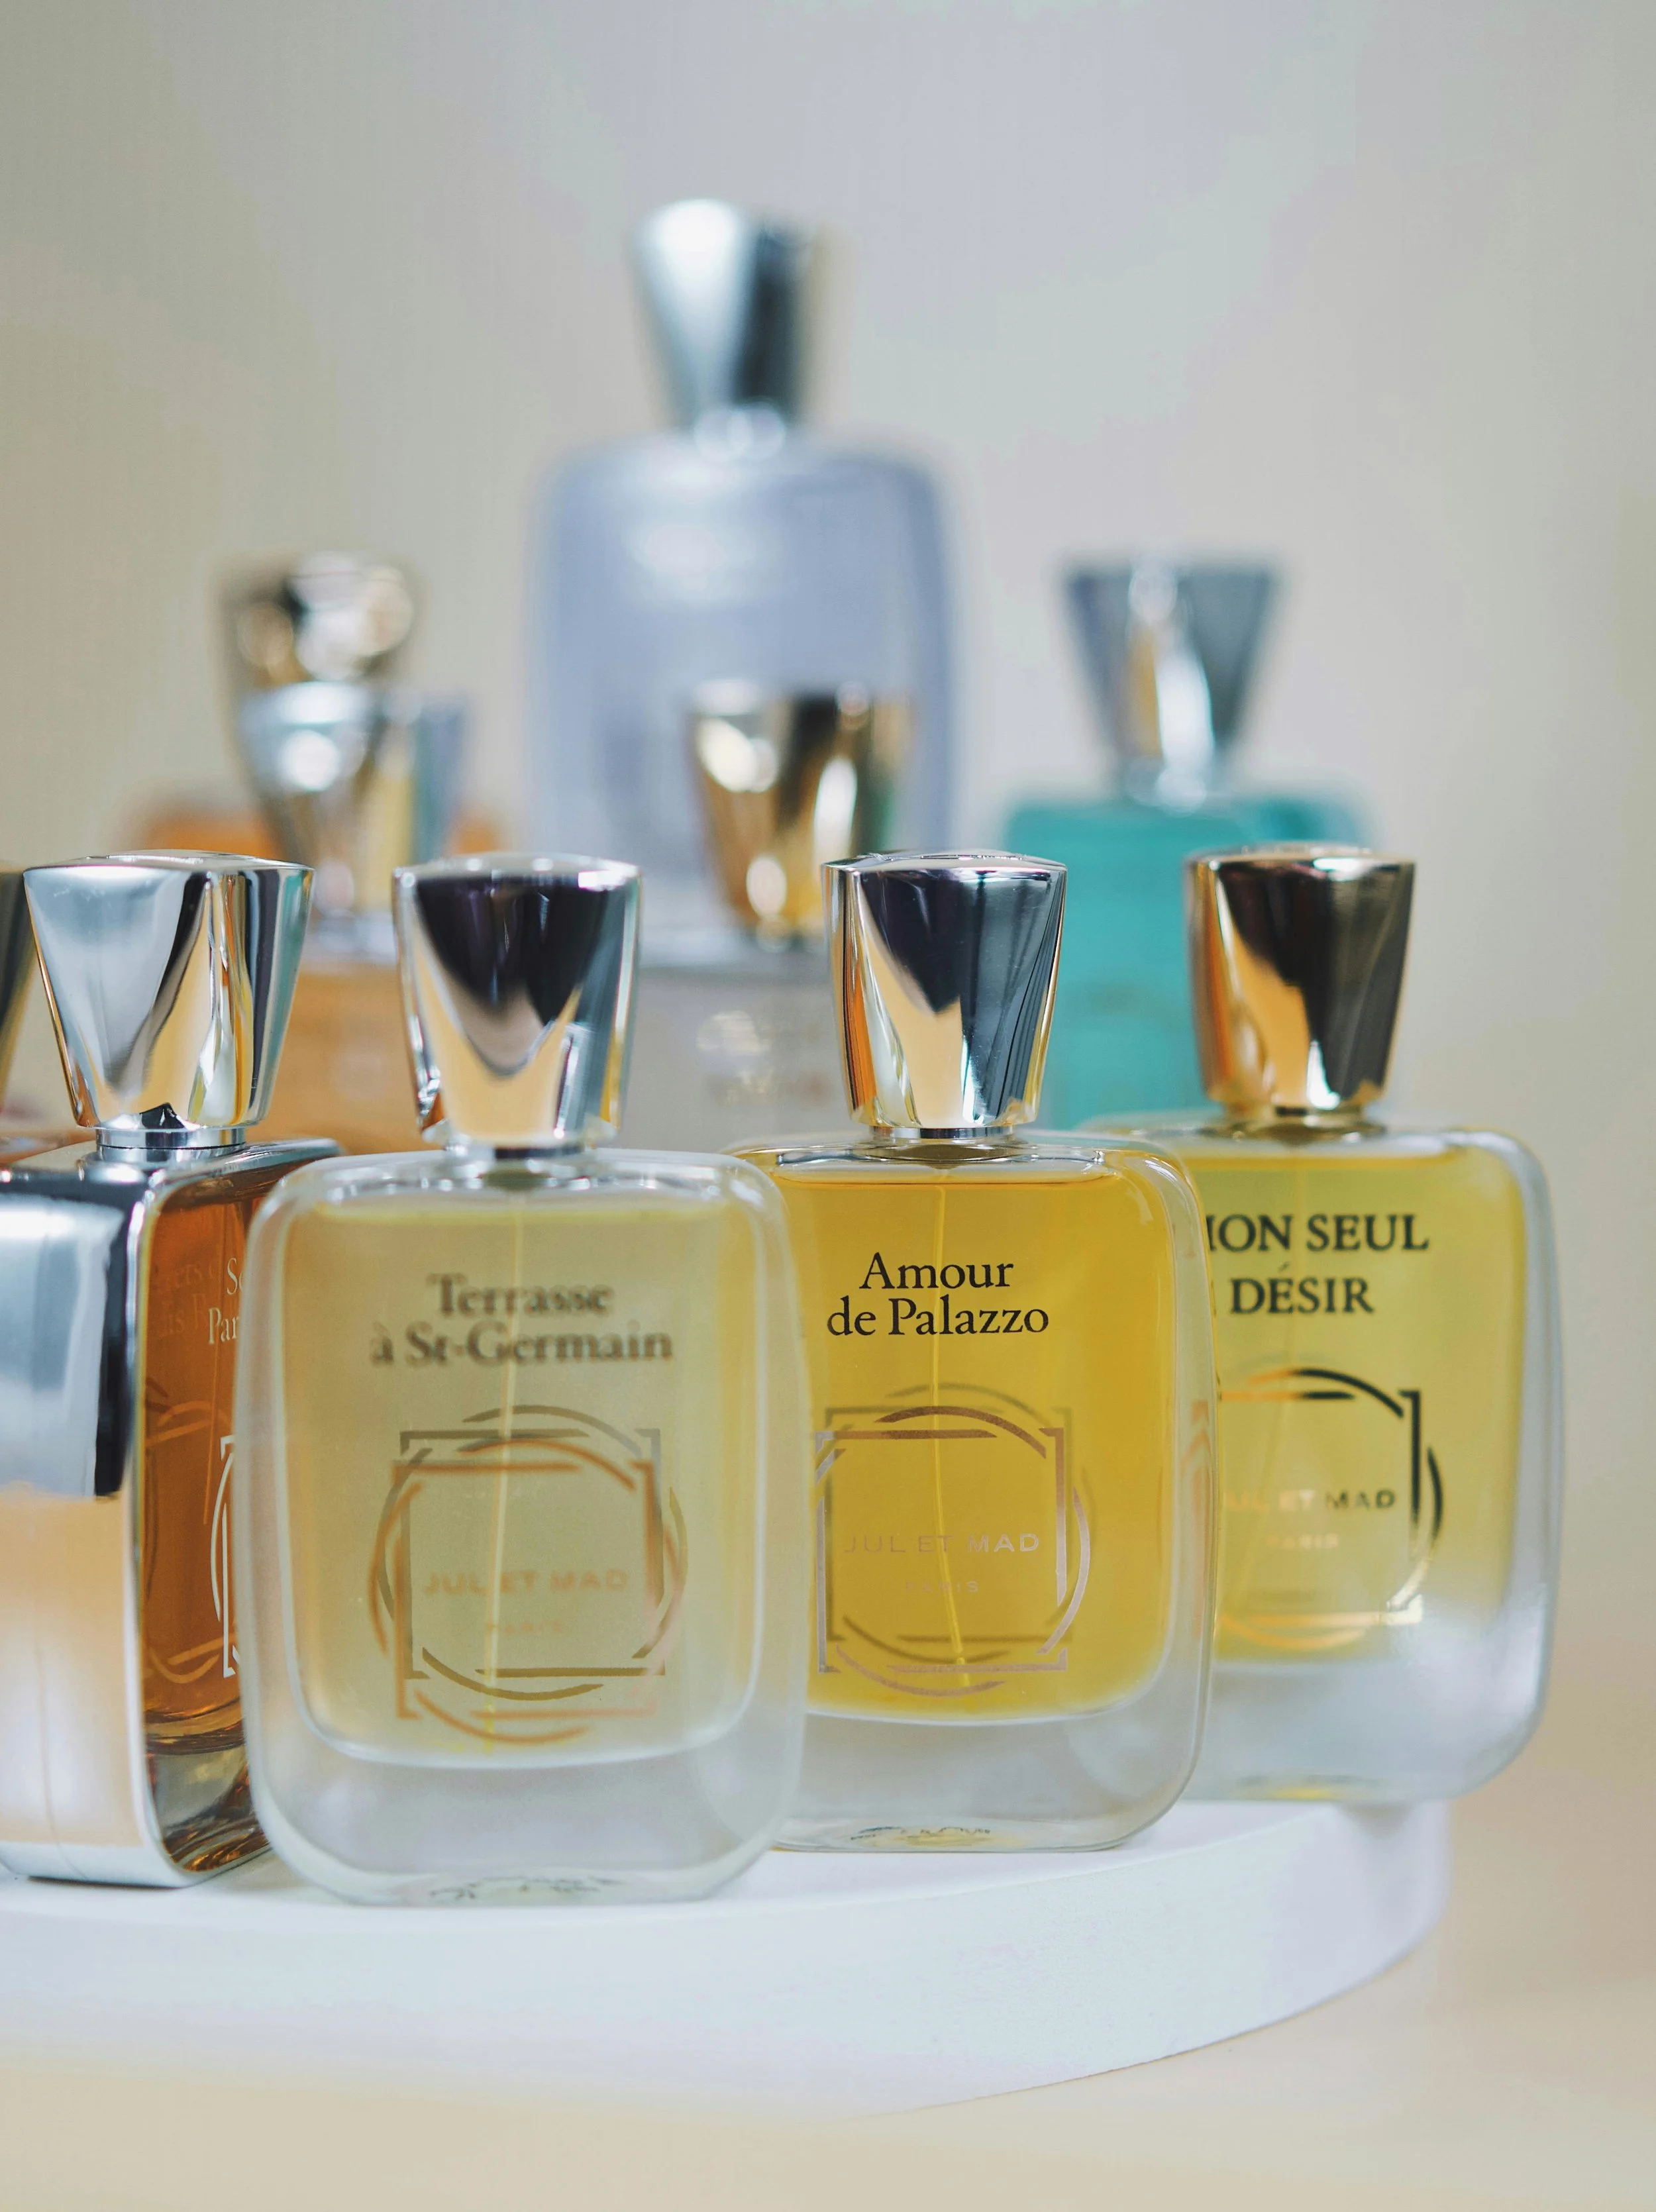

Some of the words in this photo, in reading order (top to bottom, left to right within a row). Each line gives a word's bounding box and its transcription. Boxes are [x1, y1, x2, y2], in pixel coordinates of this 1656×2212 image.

[1306, 1213, 1429, 1252] SEUL
[859, 1252, 1013, 1289] Amour
[1229, 1261, 1374, 1315] DÉSIR
[426, 1273, 615, 1317] Terrasse
[208, 1307, 239, 1344] Par
[827, 1295, 876, 1335] de
[888, 1294, 1049, 1335] Palazzo
[370, 1322, 395, 1366] à
[405, 1321, 674, 1366] St-Germain
[1325, 1488, 1396, 1509] MAD
[845, 1535, 906, 1553] JUL
[918, 1535, 953, 1552] ET
[967, 1533, 1040, 1552] MAD
[905, 1580, 979, 1594] PARIS
